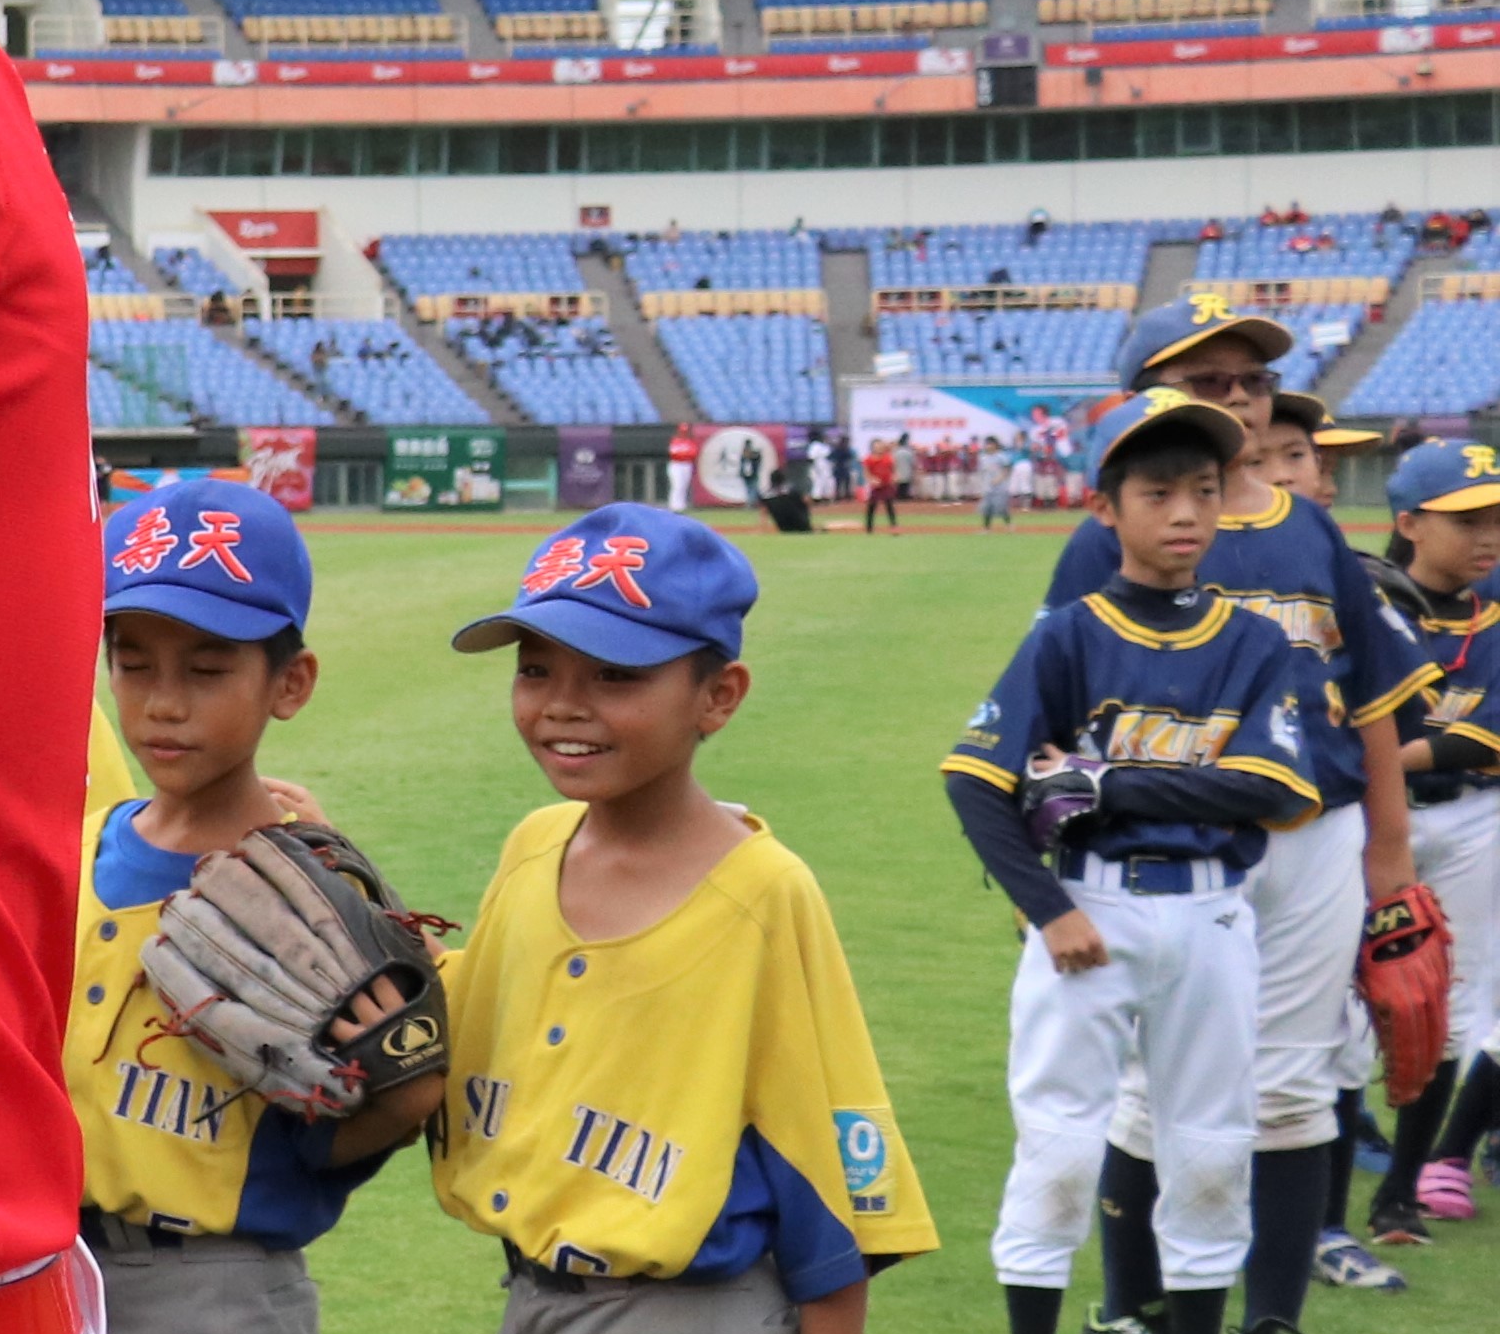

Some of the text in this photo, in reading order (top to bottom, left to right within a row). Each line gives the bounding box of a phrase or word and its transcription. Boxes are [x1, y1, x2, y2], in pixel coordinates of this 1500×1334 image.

[111, 506, 255, 585] 壽天
[521, 535, 653, 609] 壽天
[112, 1061, 230, 1145] TIAN
[564, 1102, 685, 1205] TIAN
